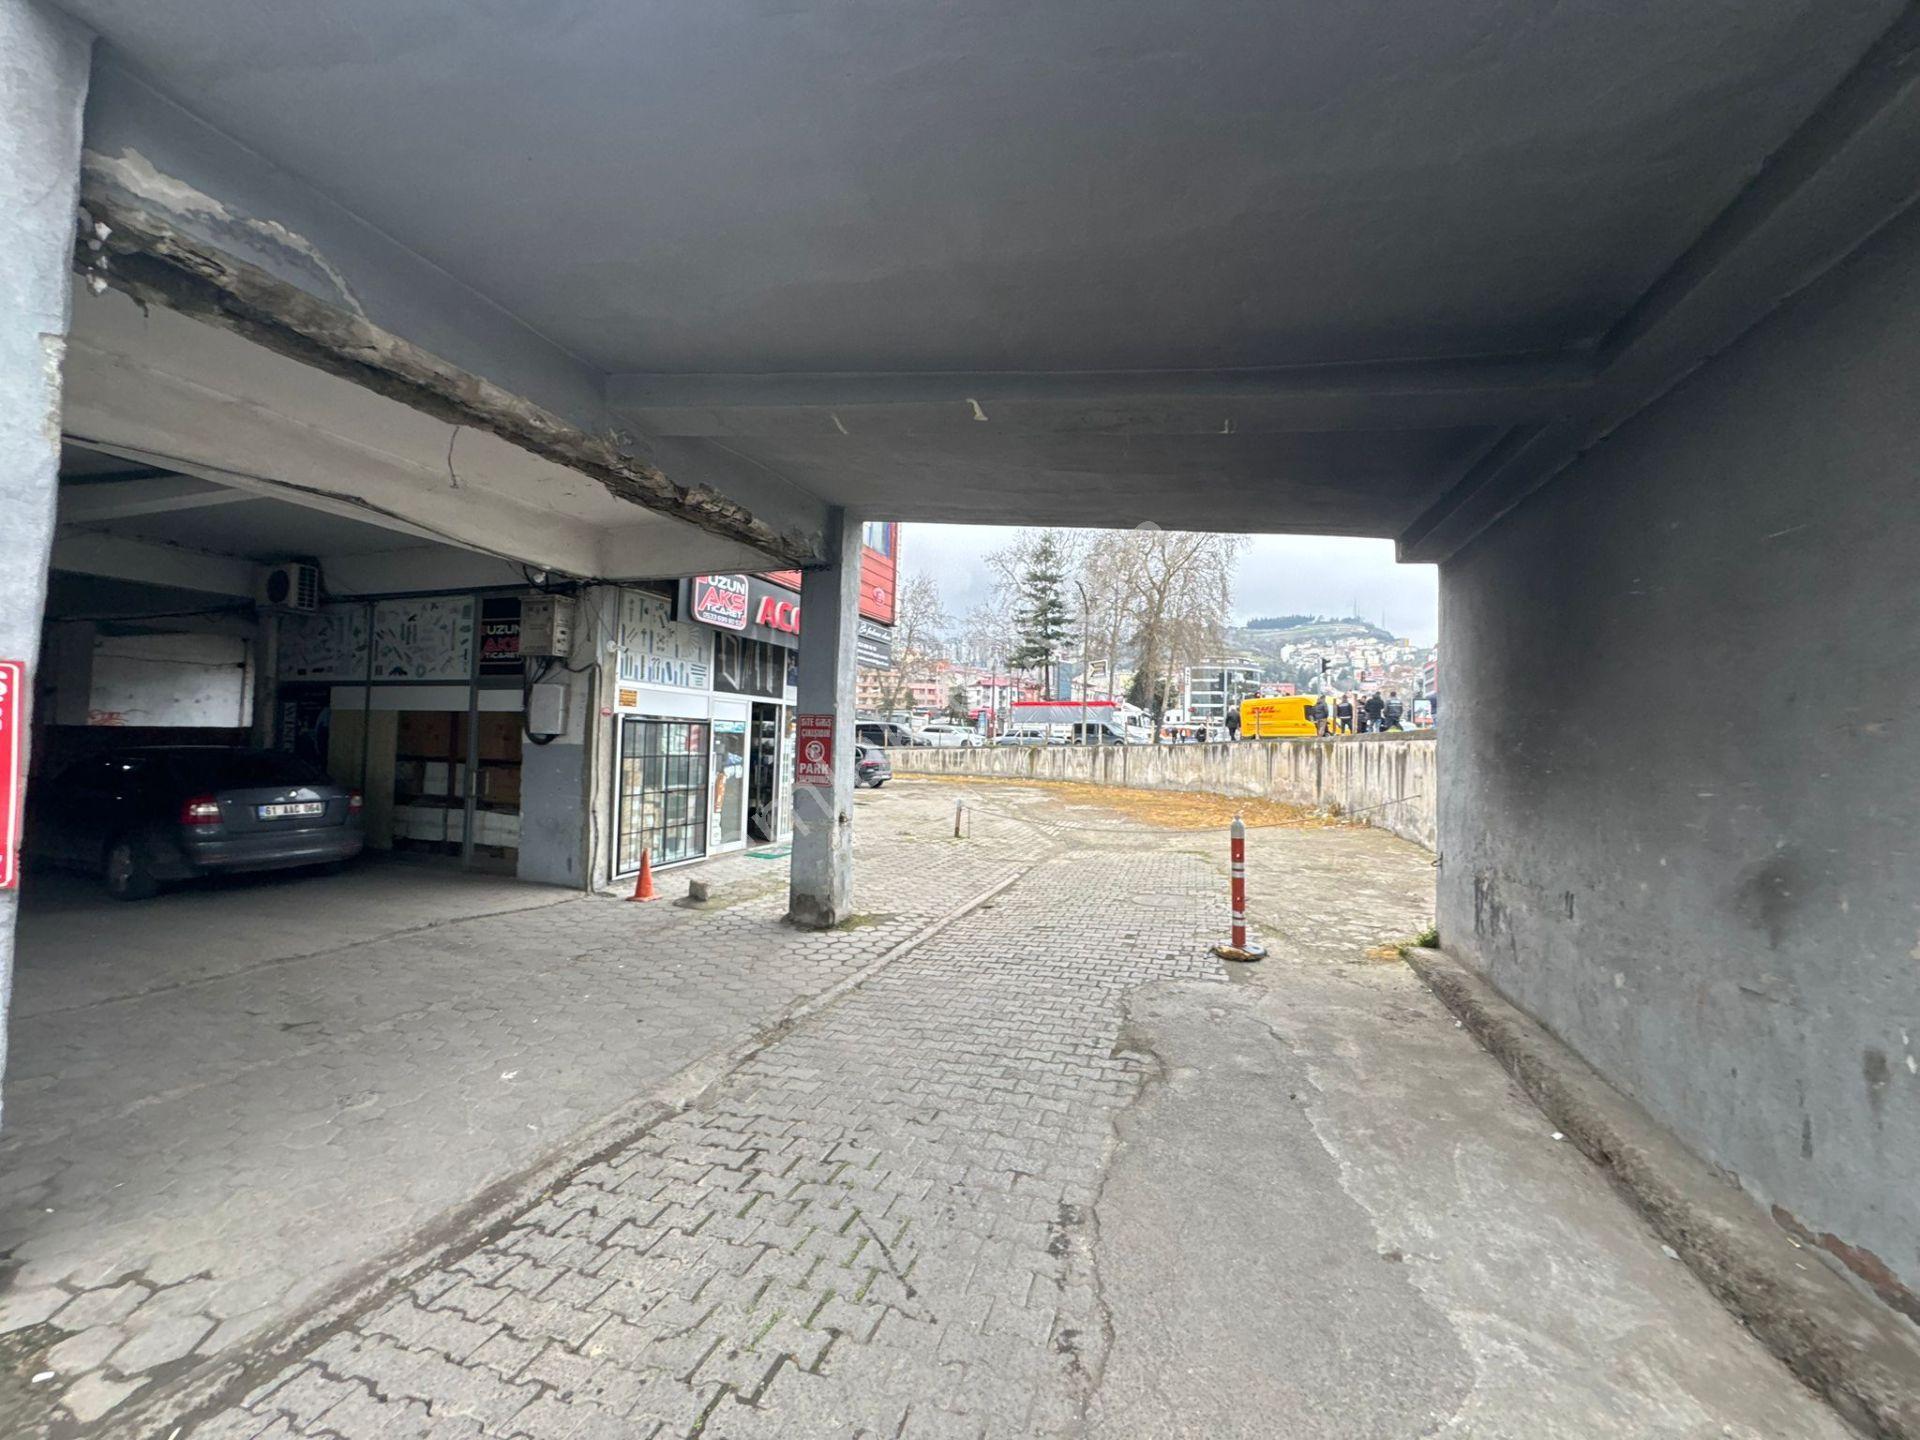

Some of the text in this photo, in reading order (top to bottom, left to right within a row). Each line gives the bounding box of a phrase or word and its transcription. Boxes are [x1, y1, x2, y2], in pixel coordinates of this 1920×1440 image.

[708, 575, 745, 594] UZUN
[698, 586, 745, 612] AKS
[799, 762, 829, 775] PARK
